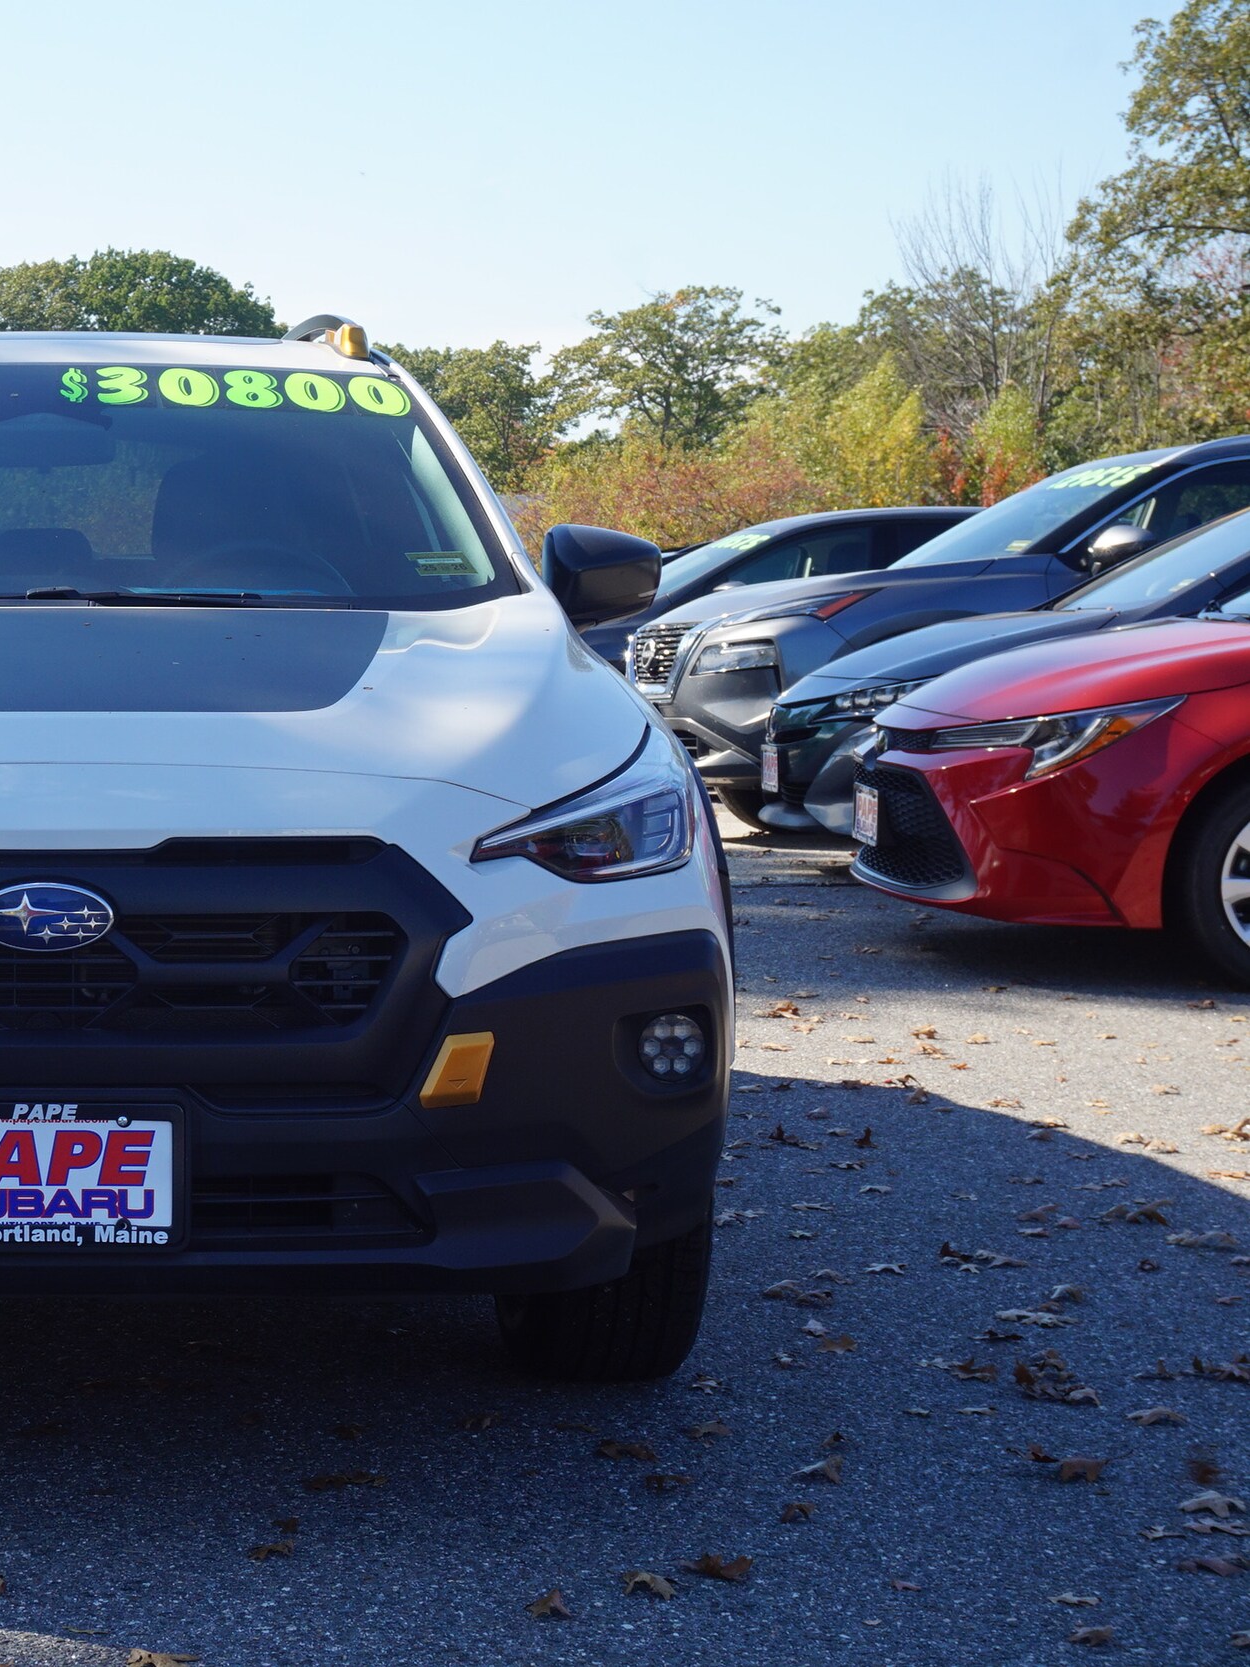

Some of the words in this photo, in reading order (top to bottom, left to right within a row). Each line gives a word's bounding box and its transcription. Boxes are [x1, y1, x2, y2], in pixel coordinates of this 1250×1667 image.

[60, 366, 411, 417] $30800
[12, 1104, 79, 1121] PAPE
[94, 1226, 169, 1245] Maine
